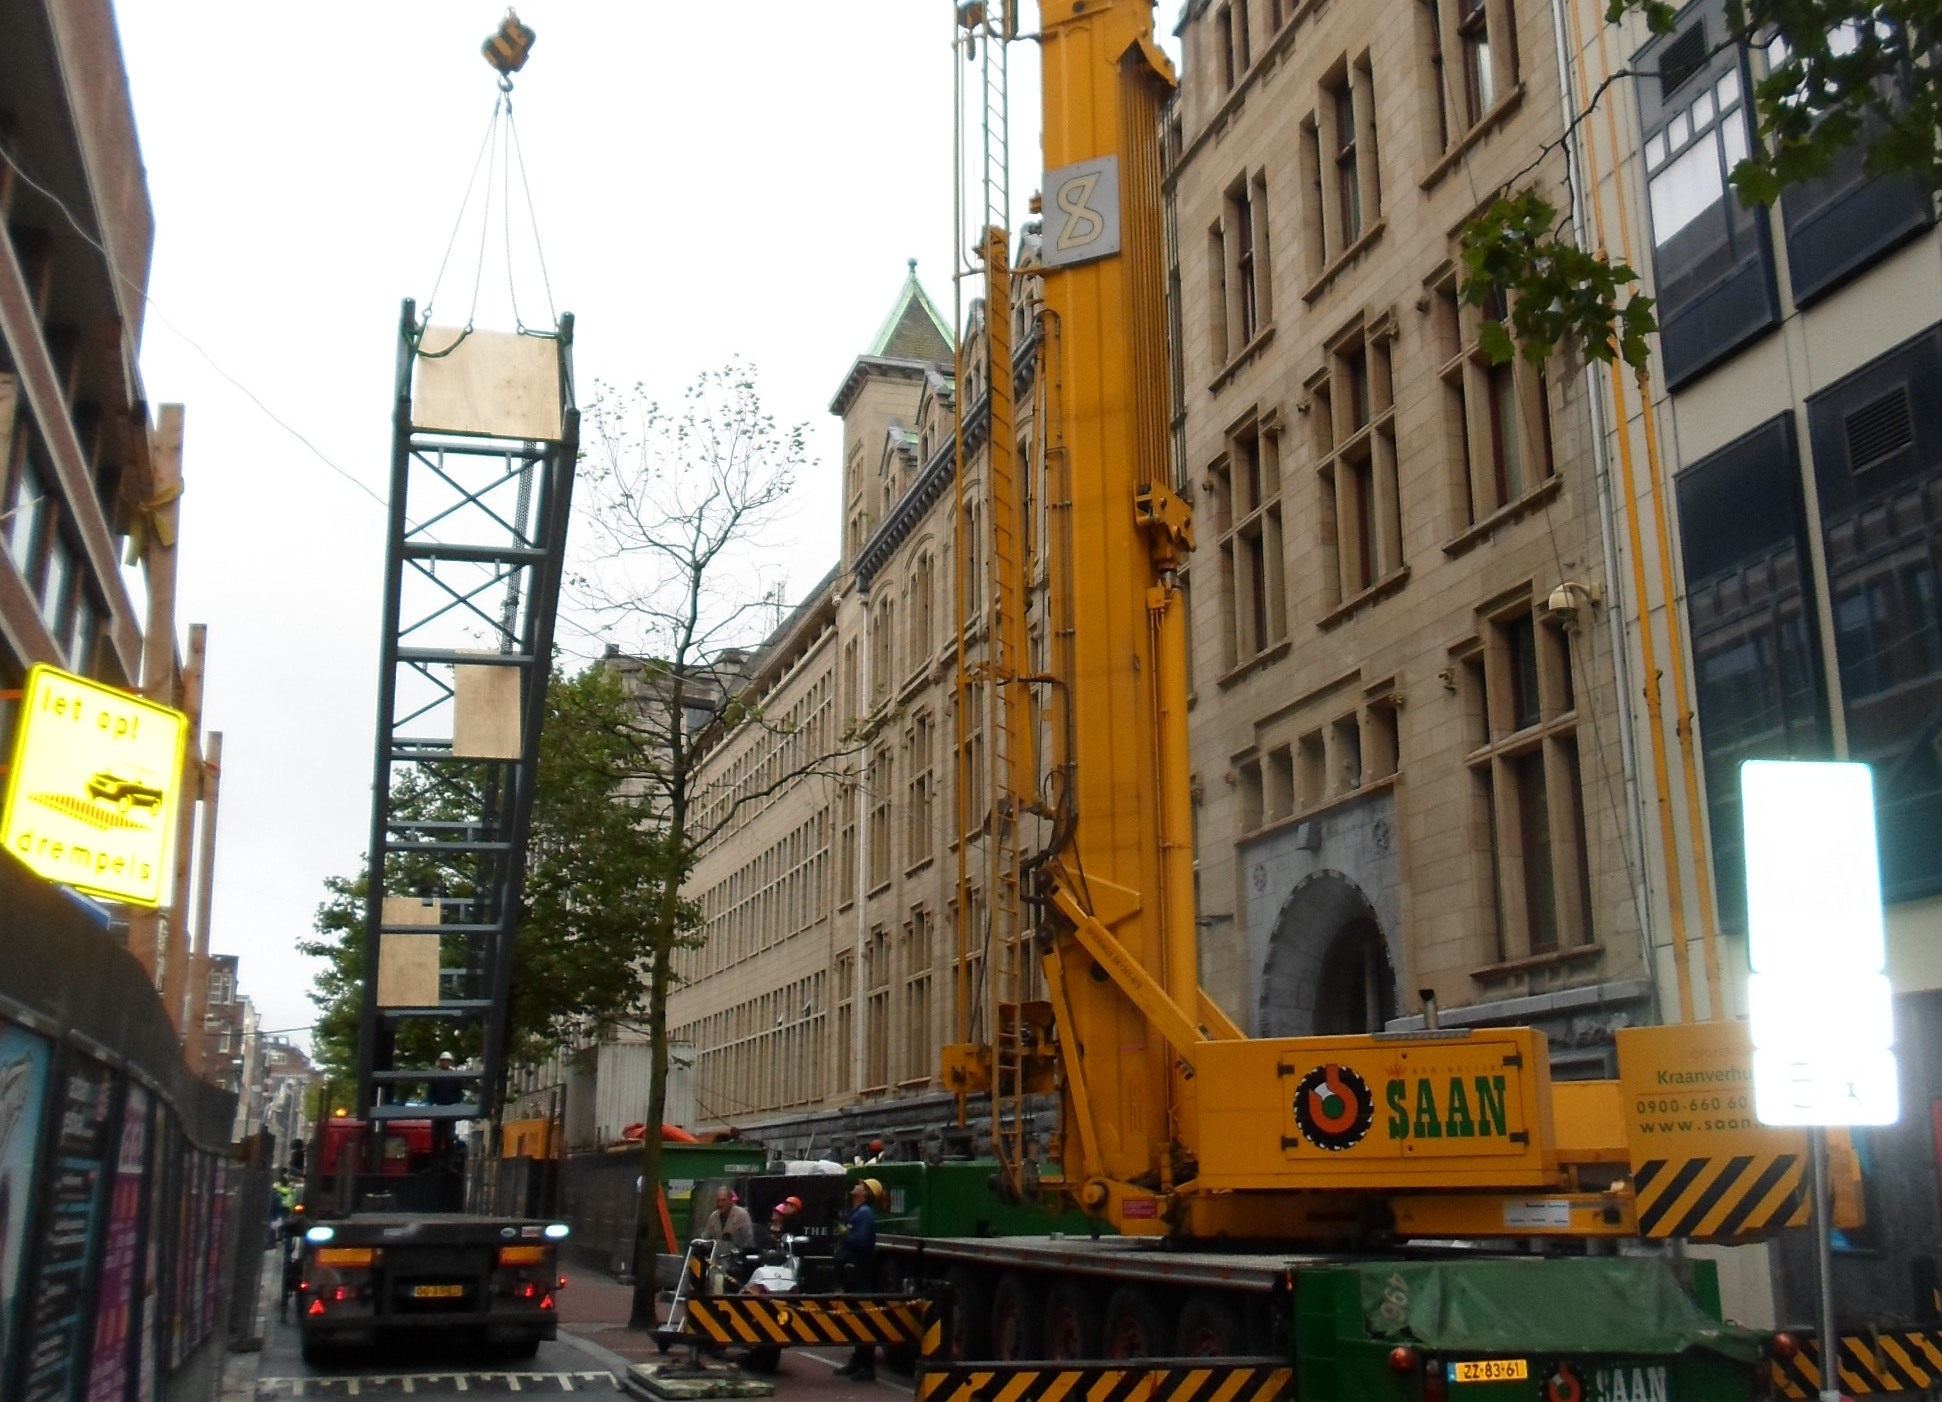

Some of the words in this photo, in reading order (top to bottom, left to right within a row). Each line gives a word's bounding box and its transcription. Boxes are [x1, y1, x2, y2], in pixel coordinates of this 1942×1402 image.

[41, 685, 83, 723] let
[97, 713, 141, 742] op!
[18, 830, 151, 880] drempels
[1657, 1066, 1754, 1086] Kraanverhu
[1386, 1075, 1507, 1140] SAAN
[1636, 1097, 1721, 1114] 0900-660
[1639, 1117, 1771, 1134] www.saan.
[803, 1226, 828, 1236] THE
[1463, 1361, 1519, 1379] ZZ-83-61
[1596, 1366, 1667, 1402] SAAN
